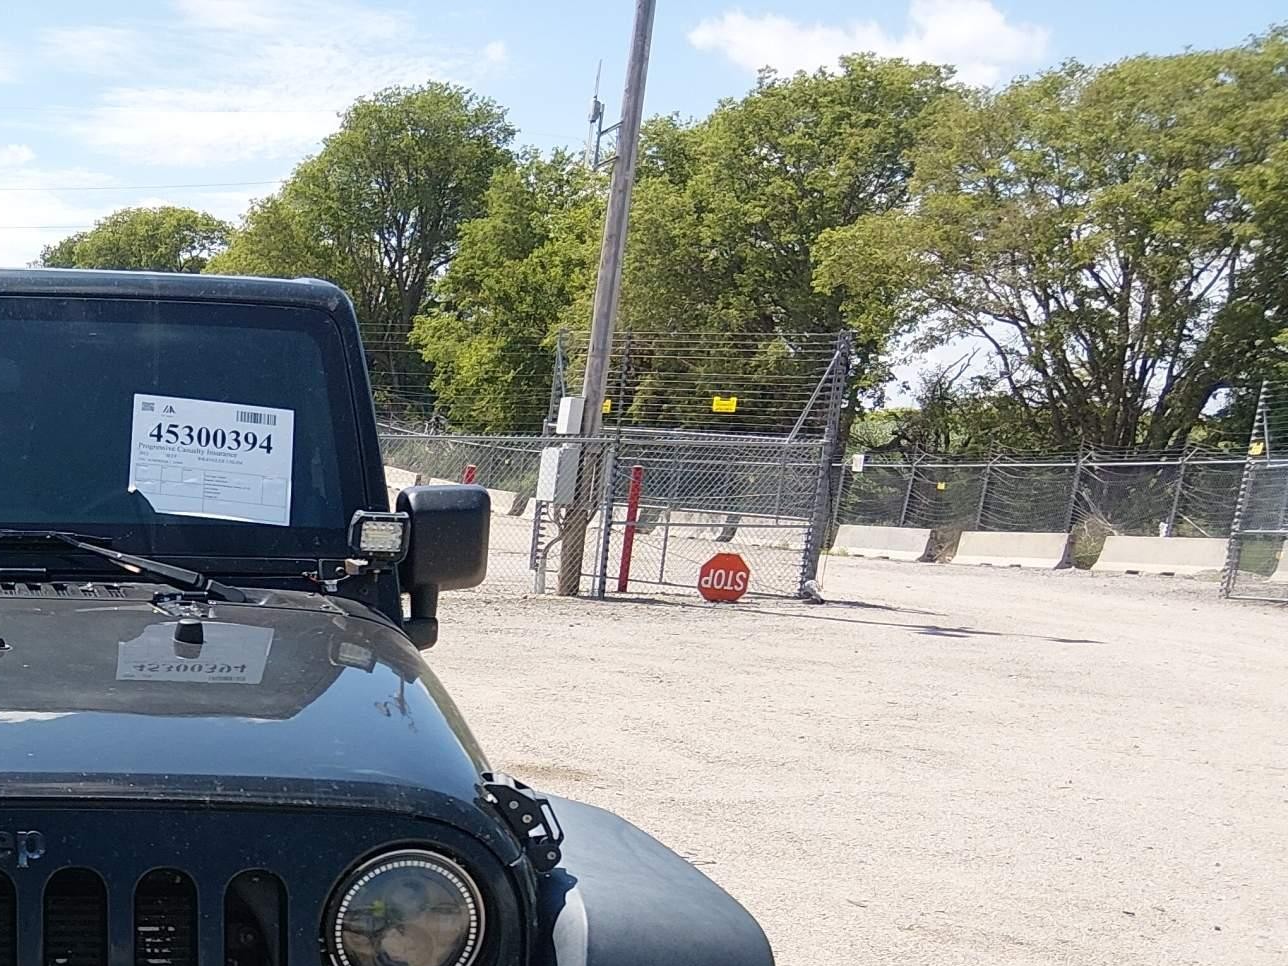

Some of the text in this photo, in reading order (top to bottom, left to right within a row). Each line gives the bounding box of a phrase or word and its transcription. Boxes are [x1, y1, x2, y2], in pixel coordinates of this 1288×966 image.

[149, 422, 273, 454] 45300394
[138, 442, 177, 452] Progressive
[177, 446, 205, 456] Casualty
[206, 448, 238, 458] Insurance
[701, 568, 747, 591] STOP
